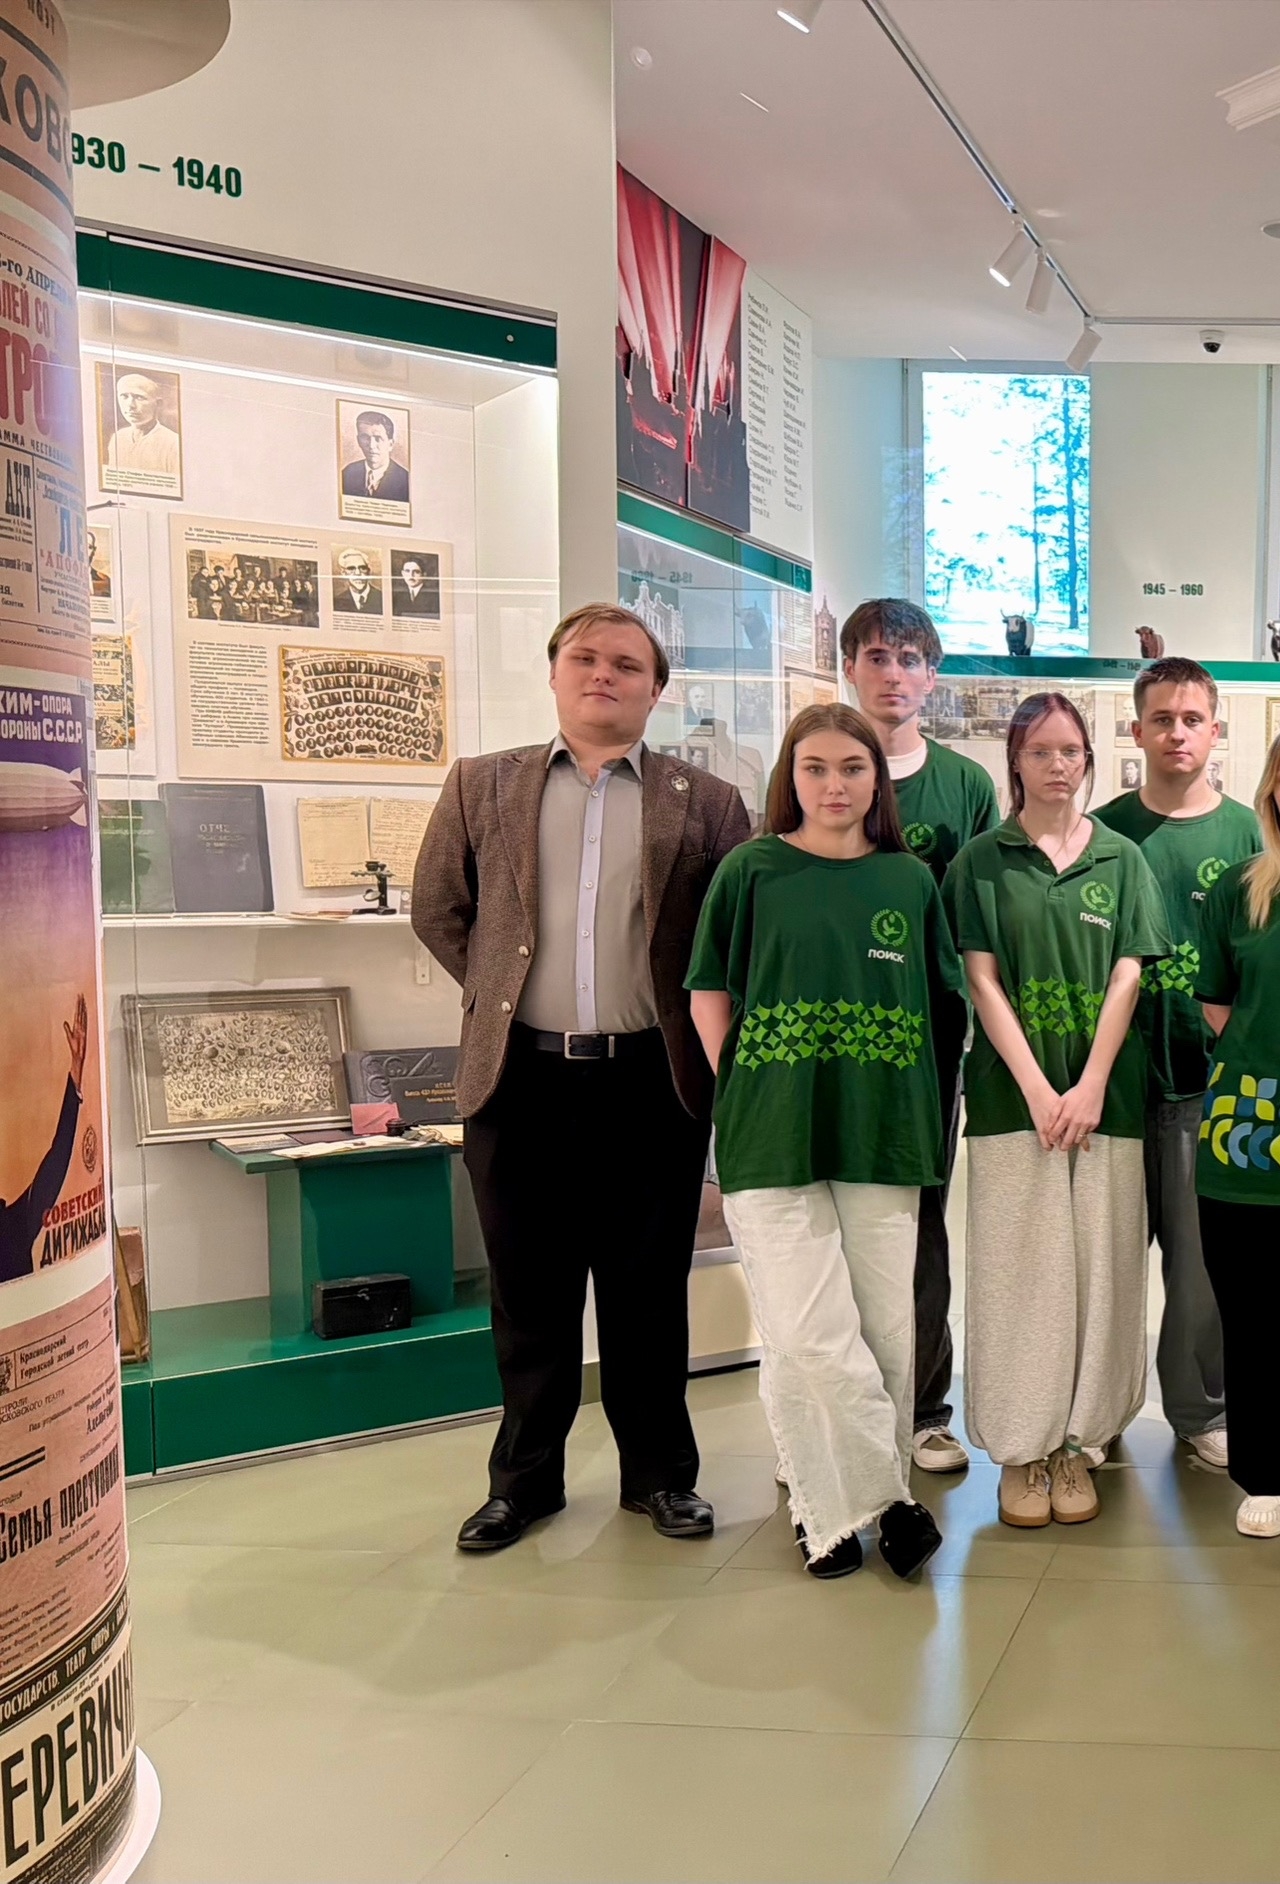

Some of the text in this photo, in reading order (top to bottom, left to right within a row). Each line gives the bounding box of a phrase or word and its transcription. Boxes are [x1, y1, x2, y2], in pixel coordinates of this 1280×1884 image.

[172, 156, 242, 198] 1940
[5, 458, 32, 520] АКТ
[1143, 583, 1165, 595] 1945
[1180, 584, 1203, 596] 1960
[1080, 912, 1112, 930] ПОИСК
[868, 949, 905, 963] ПОИСК
[65, 1646, 87, 1678] ТЕАТР
